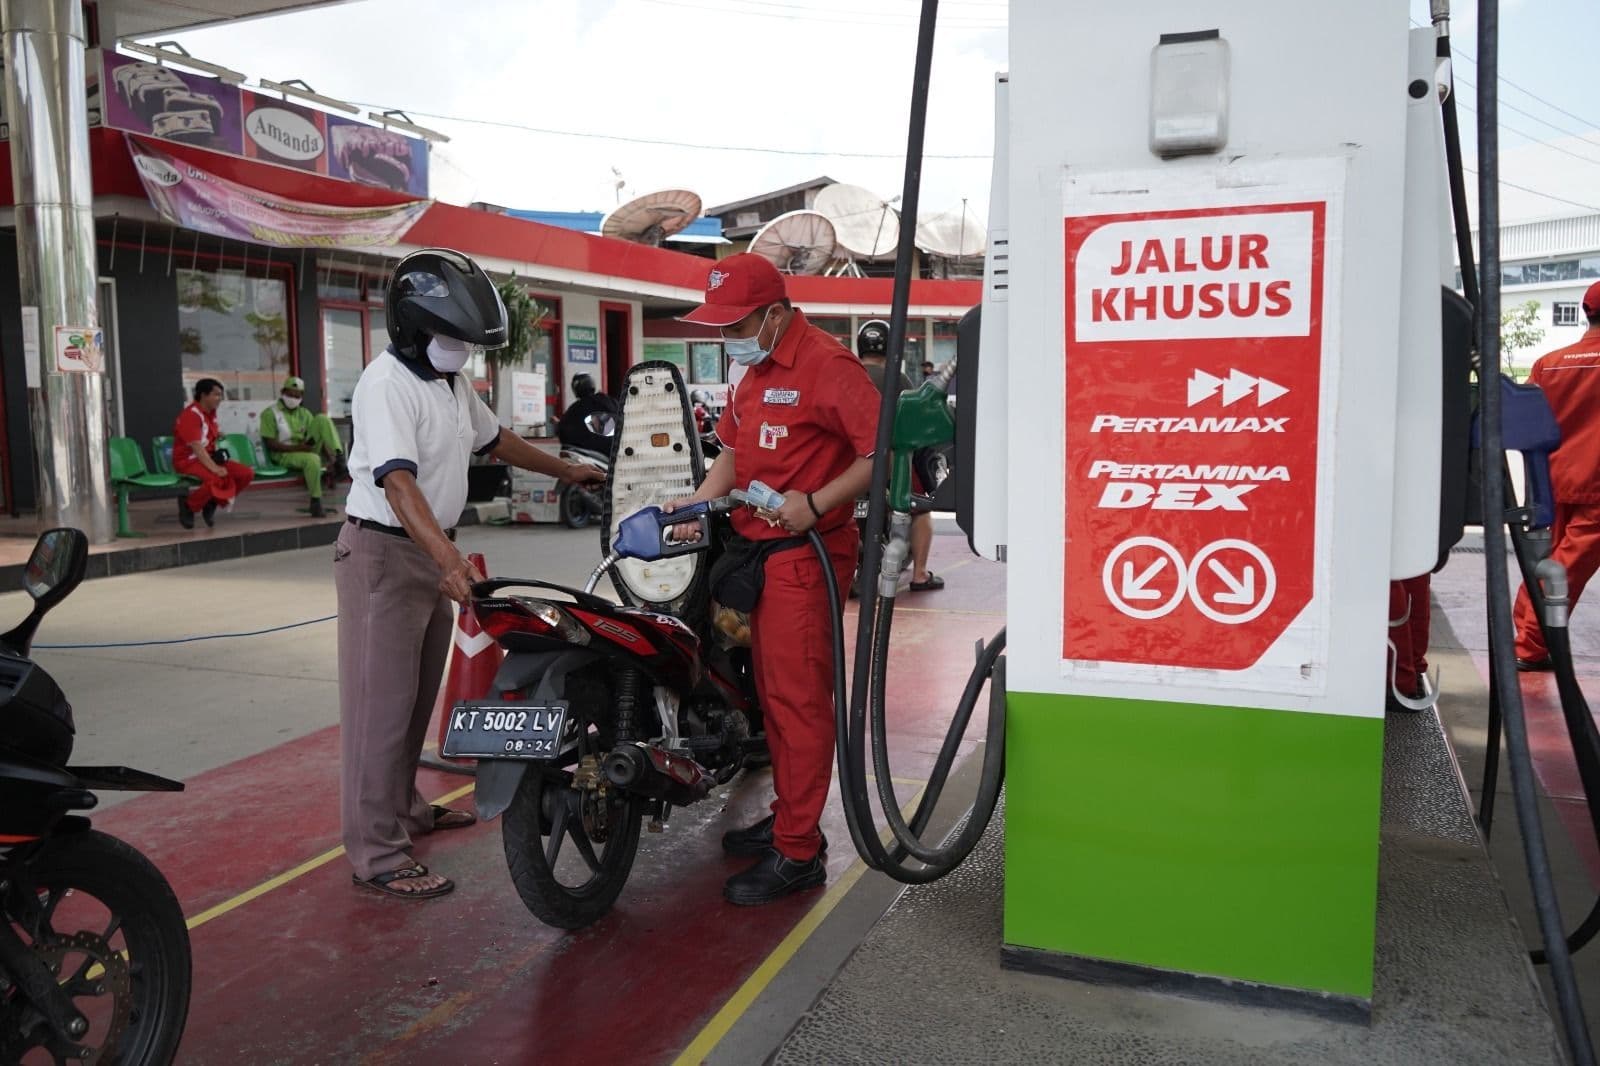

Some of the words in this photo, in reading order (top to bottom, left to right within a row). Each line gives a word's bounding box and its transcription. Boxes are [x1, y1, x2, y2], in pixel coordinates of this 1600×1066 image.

[253, 114, 320, 153] Amanda
[1110, 233, 1270, 276] JALUR
[1091, 280, 1293, 323] KHUSUS
[570, 348, 595, 361] TOILET
[1090, 414, 1291, 433] PERTAMAX
[1087, 459, 1291, 482] PERTAMINA
[1097, 481, 1260, 511] DEX
[593, 618, 641, 643] 125
[453, 711, 479, 730] KT
[483, 711, 528, 731] 5002
[532, 712, 559, 732] LV
